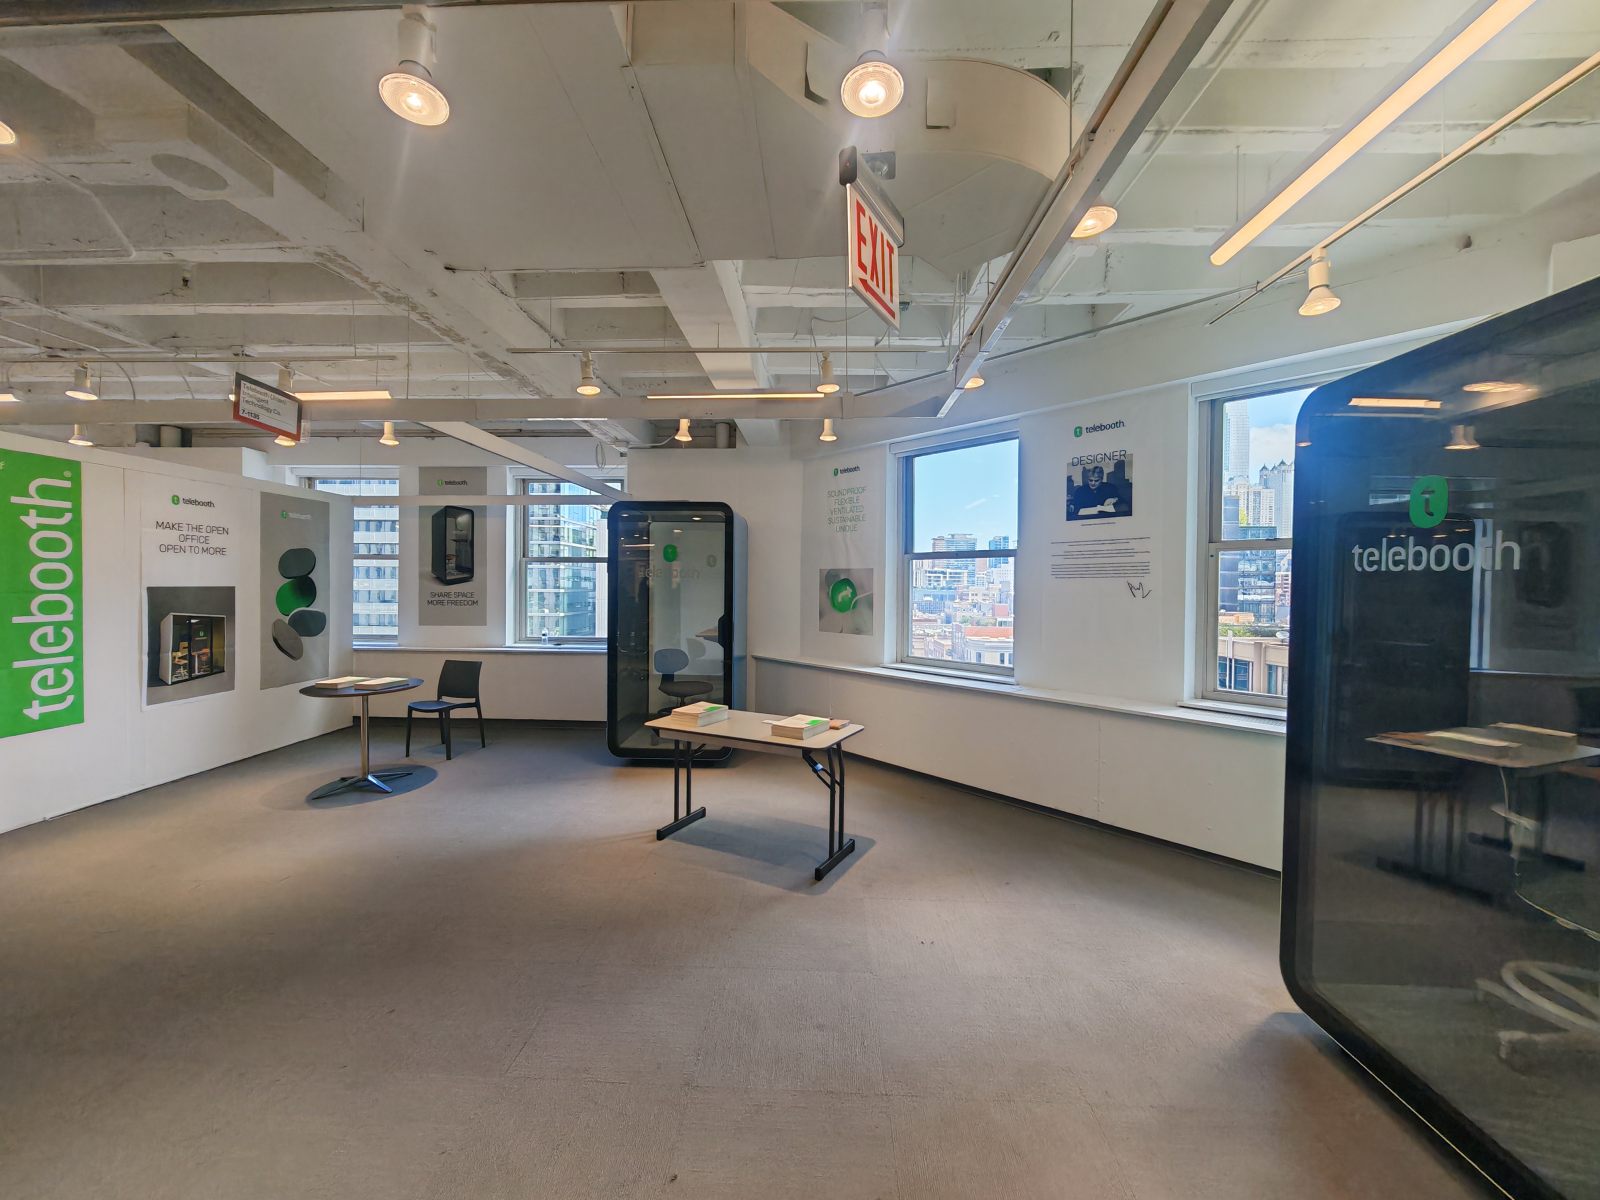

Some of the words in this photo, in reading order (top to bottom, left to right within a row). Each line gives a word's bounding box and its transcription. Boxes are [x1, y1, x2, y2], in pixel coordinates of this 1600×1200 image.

[856, 199, 894, 303] EXIT
[1071, 449, 1127, 467] DESIGNER
[834, 496, 860, 506] FLEXIBLE
[155, 520, 184, 532] MAKE
[186, 523, 204, 534] THE
[205, 525, 230, 536] OPEN
[178, 534, 210, 544] OFFICE
[159, 543, 186, 554] OPEN
[188, 545, 200, 555] TO
[201, 546, 228, 556] MORE
[1351, 529, 1521, 573] telebooth
[10, 471, 74, 720] telebooth.
[430, 591, 453, 599] SHARE
[454, 591, 476, 599] SPACE
[427, 599, 446, 607] MORE
[447, 599, 479, 607] FREEDOM
